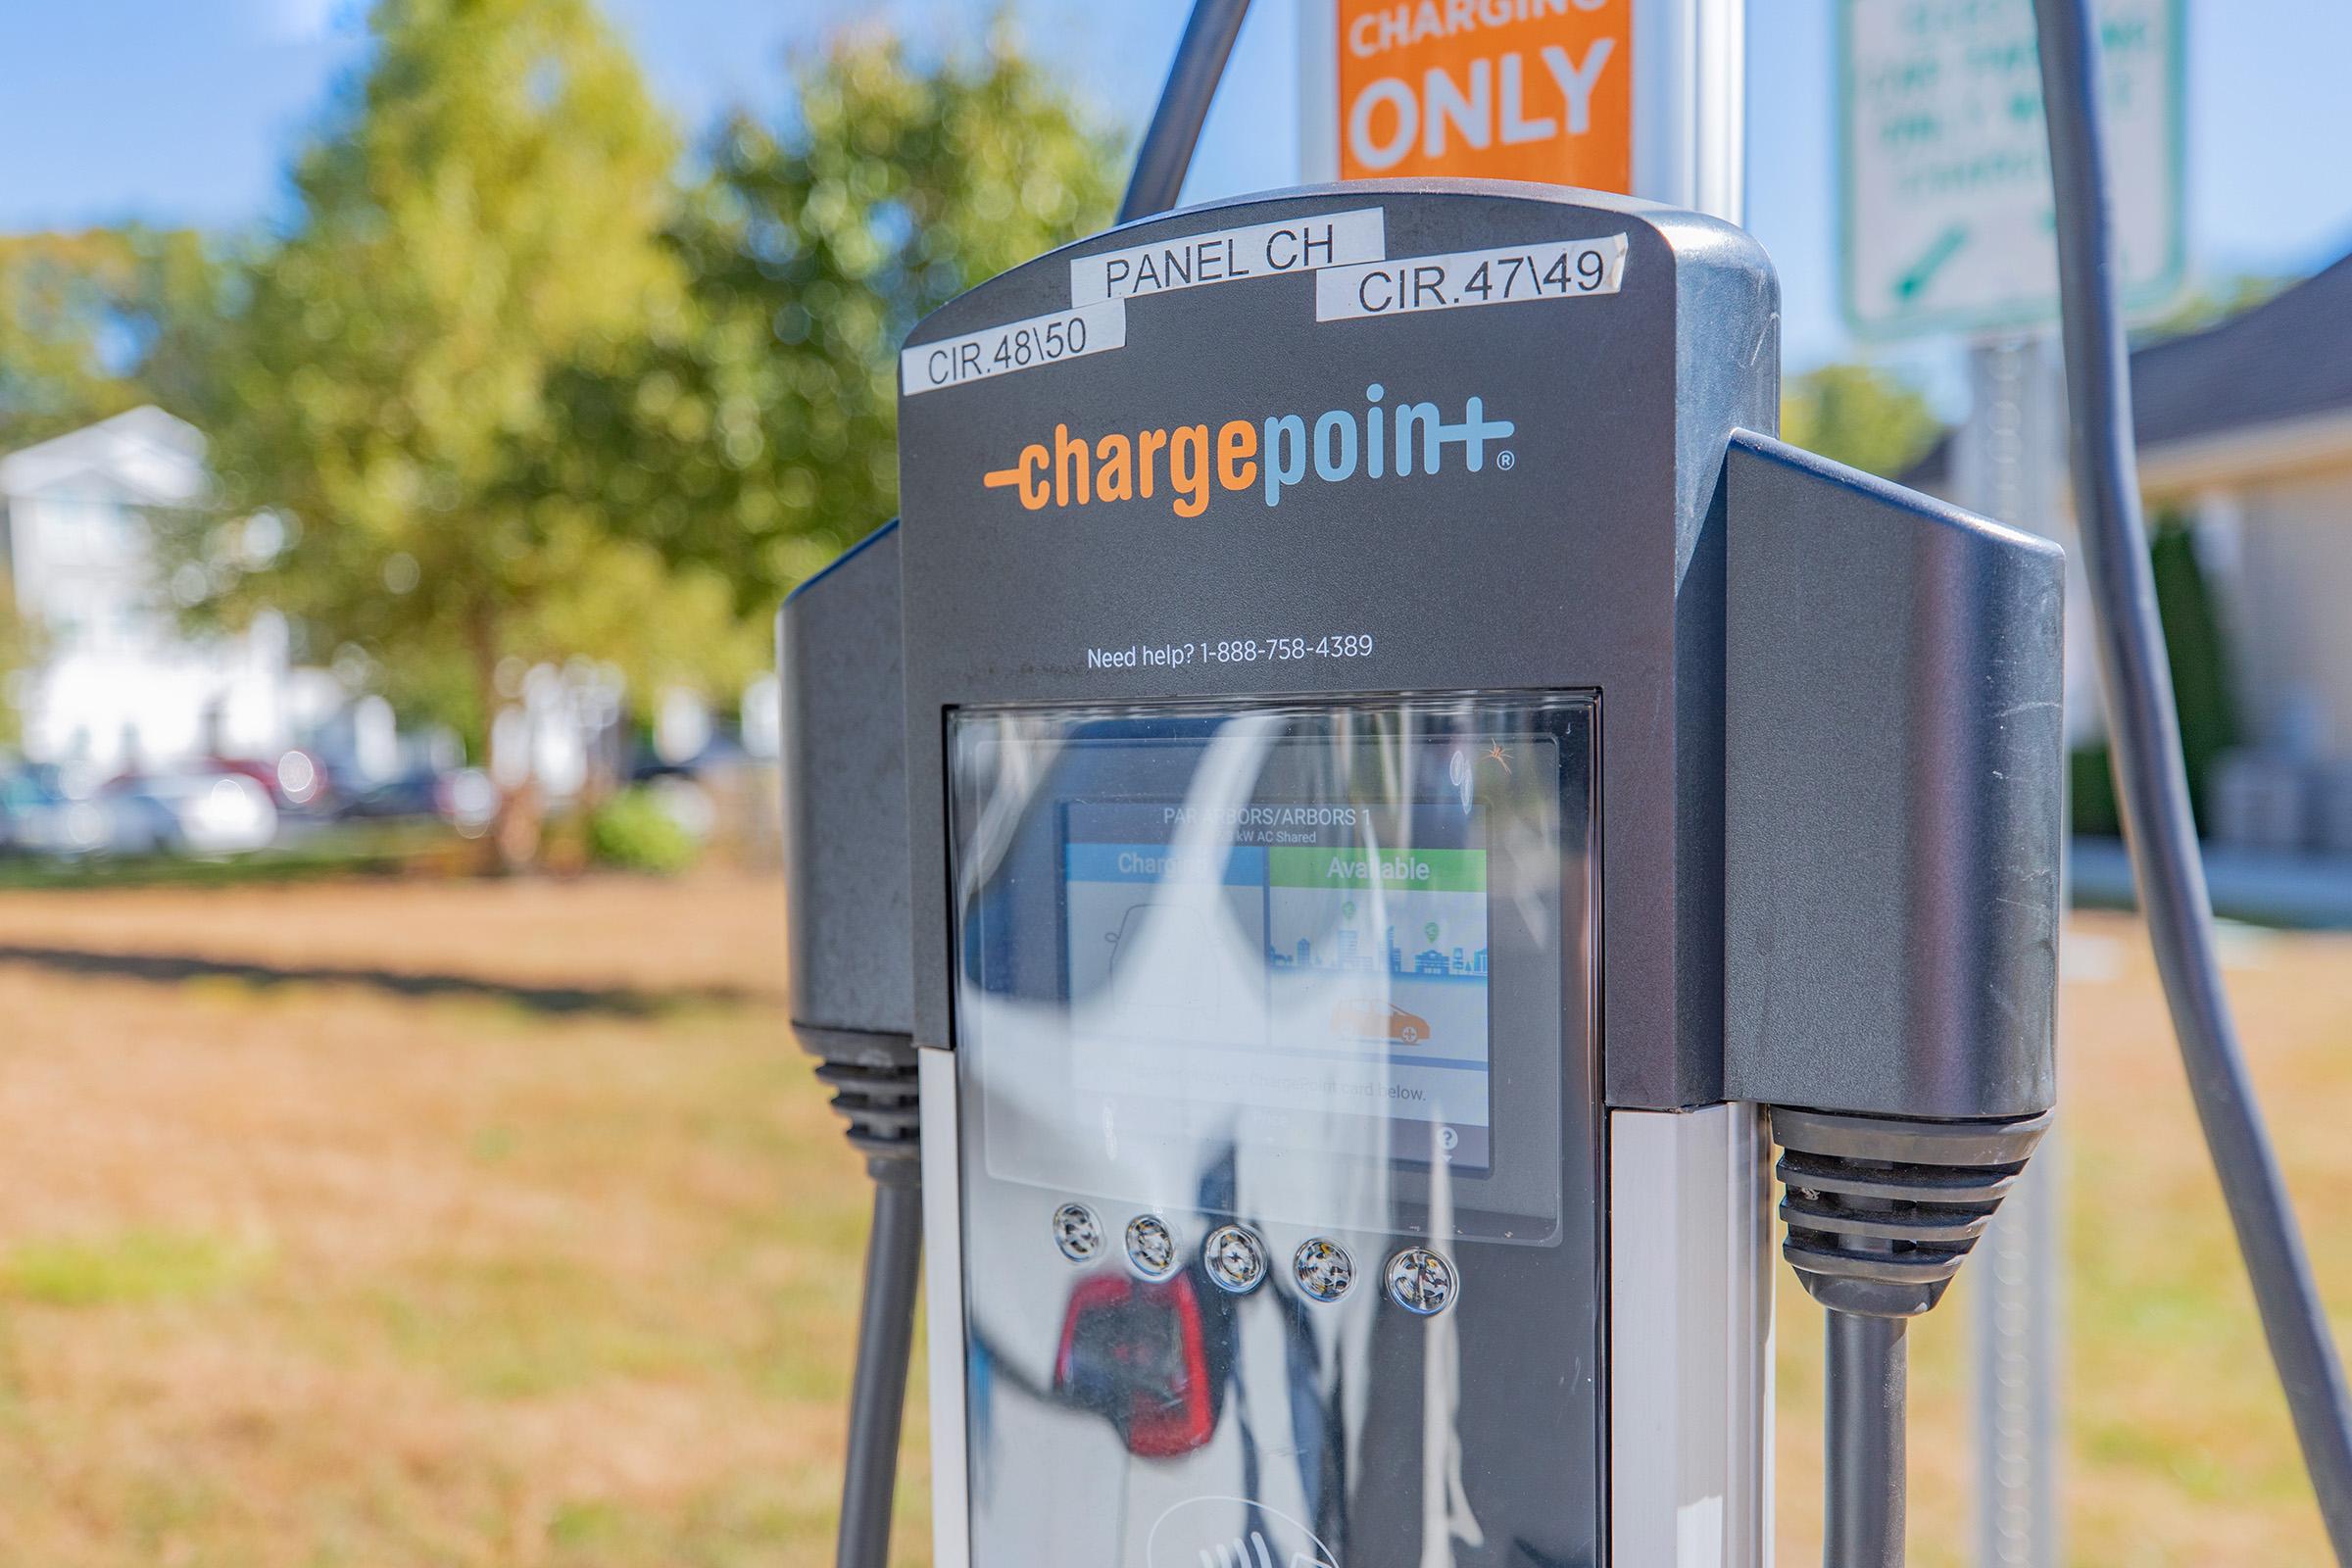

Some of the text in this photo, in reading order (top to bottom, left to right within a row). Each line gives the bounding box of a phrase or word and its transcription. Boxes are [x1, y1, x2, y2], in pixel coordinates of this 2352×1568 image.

[1348, 0, 1608, 58] CHARG
[1348, 37, 1617, 171] ONLY
[1106, 223, 1334, 298] PANEL CH
[1358, 250, 1605, 313] CIR.47\49
[928, 317, 1087, 385] CIR.48\50
[1088, 635, 1373, 669] Need help? 1-888-758-4389
[1117, 851, 1207, 880] Charg
[1257, 831, 1274, 844] AC
[1276, 831, 1317, 845] Shared
[1326, 856, 1431, 881] Avaable
